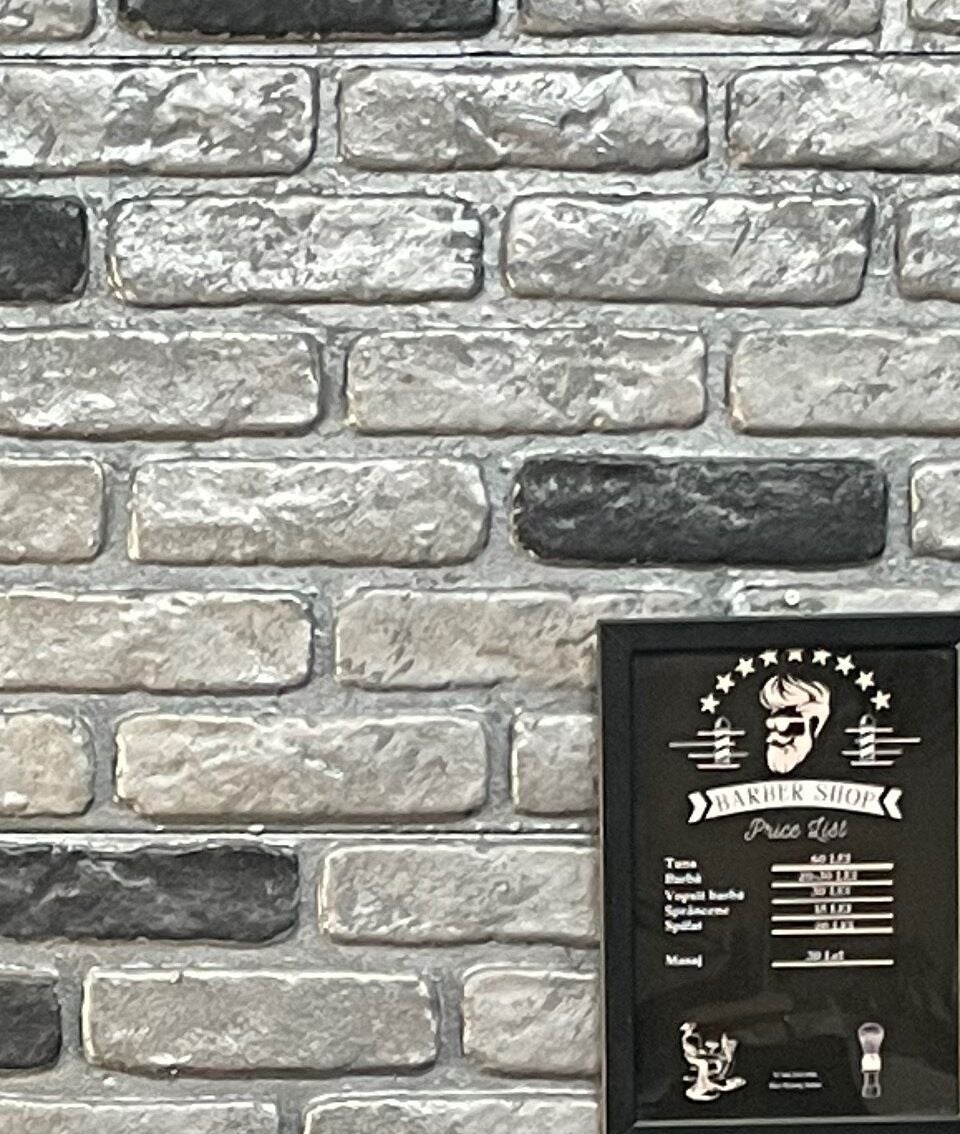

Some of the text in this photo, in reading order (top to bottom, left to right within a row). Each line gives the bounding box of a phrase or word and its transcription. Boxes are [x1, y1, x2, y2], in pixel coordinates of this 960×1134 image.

[715, 783, 875, 812] BARBER SHOP
[744, 816, 848, 843] Price List
